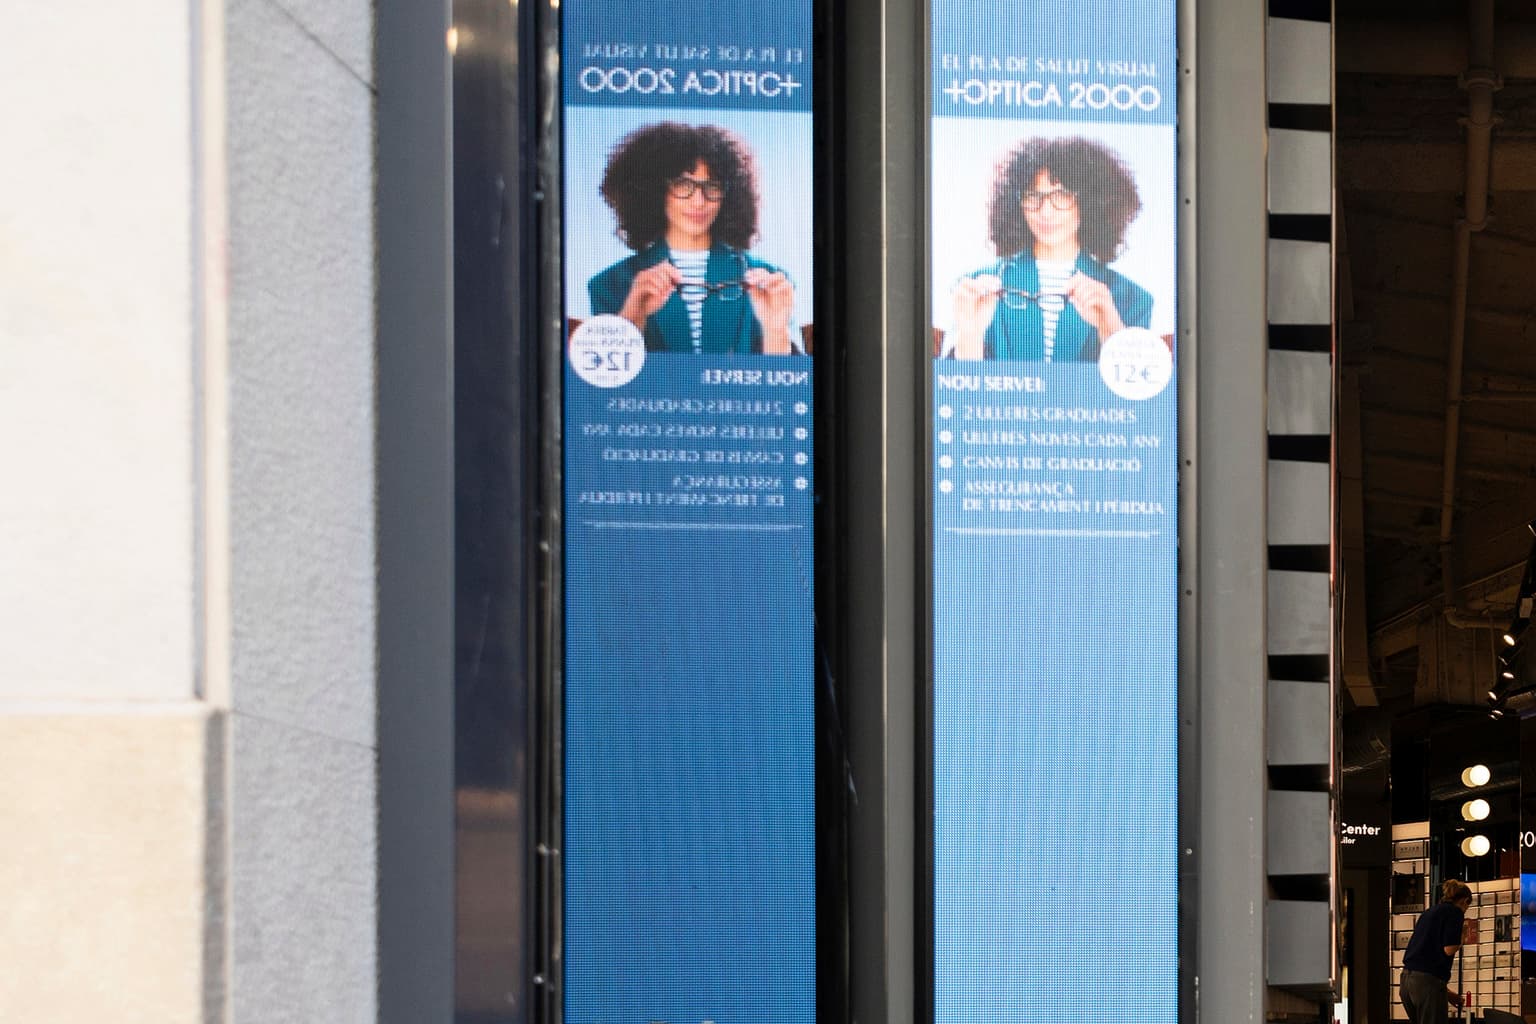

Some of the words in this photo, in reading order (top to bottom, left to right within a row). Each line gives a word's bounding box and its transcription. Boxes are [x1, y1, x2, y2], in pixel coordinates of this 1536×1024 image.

[1068, 81, 1162, 111] 2000
[938, 374, 980, 391] NOU
[1112, 364, 1161, 385] 12€
